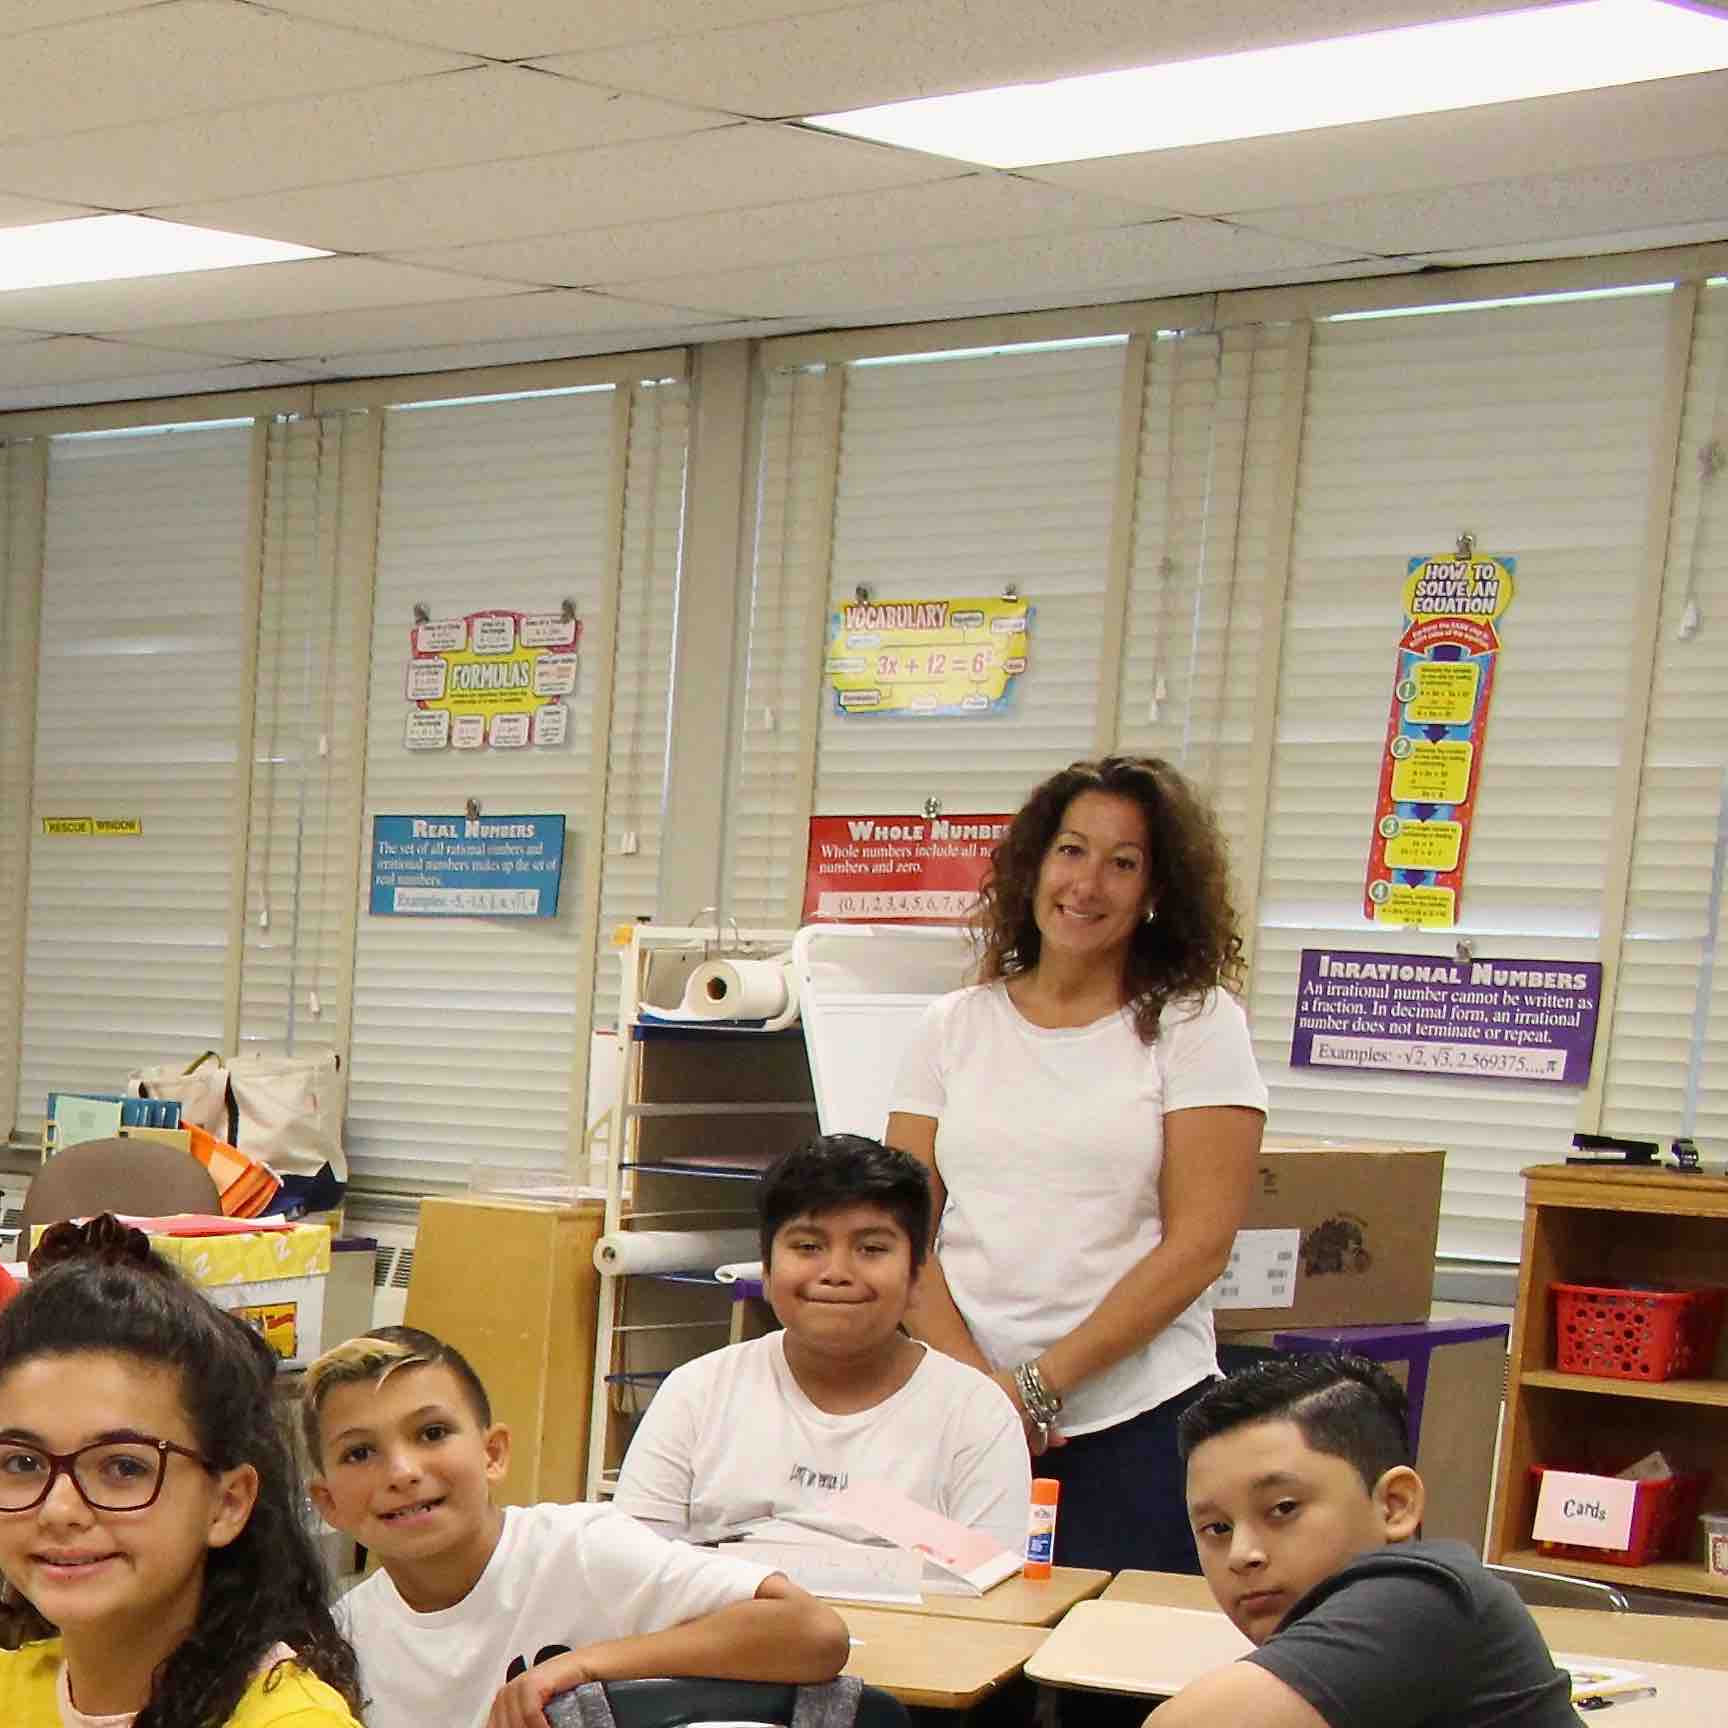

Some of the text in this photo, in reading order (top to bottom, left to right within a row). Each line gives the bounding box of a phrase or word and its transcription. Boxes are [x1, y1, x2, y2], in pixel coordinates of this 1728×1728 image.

[1425, 563, 1496, 581] HOW TO
[1415, 580, 1500, 598] SOLVE AN
[844, 602, 948, 629] VOCABULARY
[1412, 597, 1496, 614] EQUATION
[877, 654, 898, 675] 3x
[928, 654, 945, 674] 12
[453, 662, 529, 690] FORMULAS
[48, 820, 137, 832] RESCUE WINDOW
[378, 841, 394, 855] The
[399, 843, 414, 855] set
[416, 842, 428, 855] of
[820, 844, 859, 858] Whole
[863, 844, 912, 858] numbers
[915, 843, 957, 858] include
[959, 843, 977, 857] all
[819, 859, 923, 874] numbers and zero.
[1303, 980, 1593, 1010] An irrational number cannot be written as
[1301, 997, 1581, 1028] a fraction. In decimal form, an irrational
[1299, 1015, 1553, 1045] number does not terminate or repeat.
[1318, 1043, 1392, 1065] Examples:
[1564, 1498, 1606, 1521] Cards
